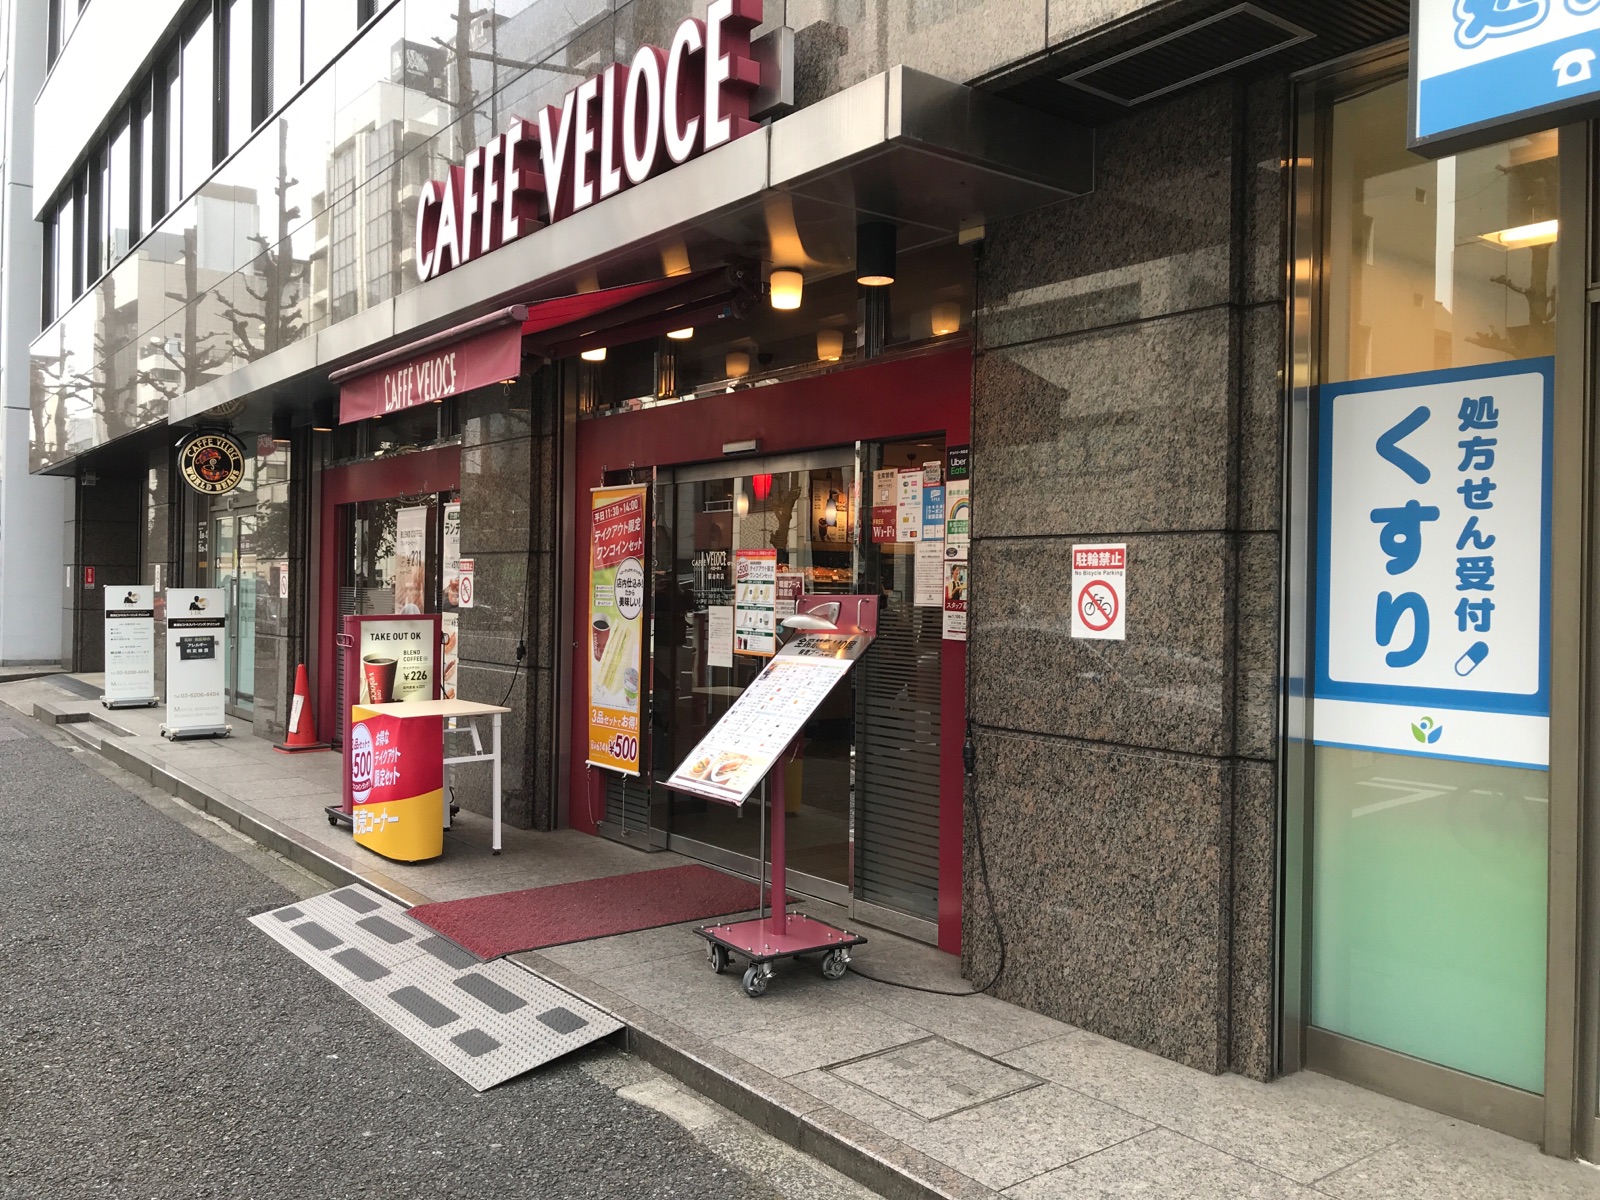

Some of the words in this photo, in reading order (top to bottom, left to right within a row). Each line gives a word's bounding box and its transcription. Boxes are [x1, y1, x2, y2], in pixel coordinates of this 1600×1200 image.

[415, 116, 523, 282] CAFFÈ
[538, 0, 735, 224] VELOCE
[384, 363, 413, 411] CAFFÈ
[416, 352, 457, 401] VELOCE
[216, 438, 240, 461] VELOCE
[950, 458, 967, 467] Uber
[950, 467, 967, 475] Eats
[185, 466, 213, 491] WORLD
[214, 469, 240, 491] BEANS
[594, 511, 605, 523] 平日
[622, 499, 639, 513] 14:00
[1454, 396, 1499, 633] 処方せん受付
[594, 516, 641, 543] テイクアウト限定
[1369, 405, 1441, 668] くすり
[596, 537, 642, 560] ワンコインセット
[706, 551, 727, 566] VELOCE
[1075, 551, 1122, 567] 駐輪禁止
[370, 632, 391, 641] TAKE
[392, 632, 409, 641] OUT
[410, 632, 422, 640] OK
[368, 671, 379, 700] veloce
[403, 670, 428, 681] ¥226
[591, 708, 638, 731] 3品セットでお得!
[375, 729, 390, 747] お得な
[374, 746, 402, 767] テイクアウト
[374, 766, 401, 787] 限定セット
[352, 808, 399, 835] 販売コーナー
